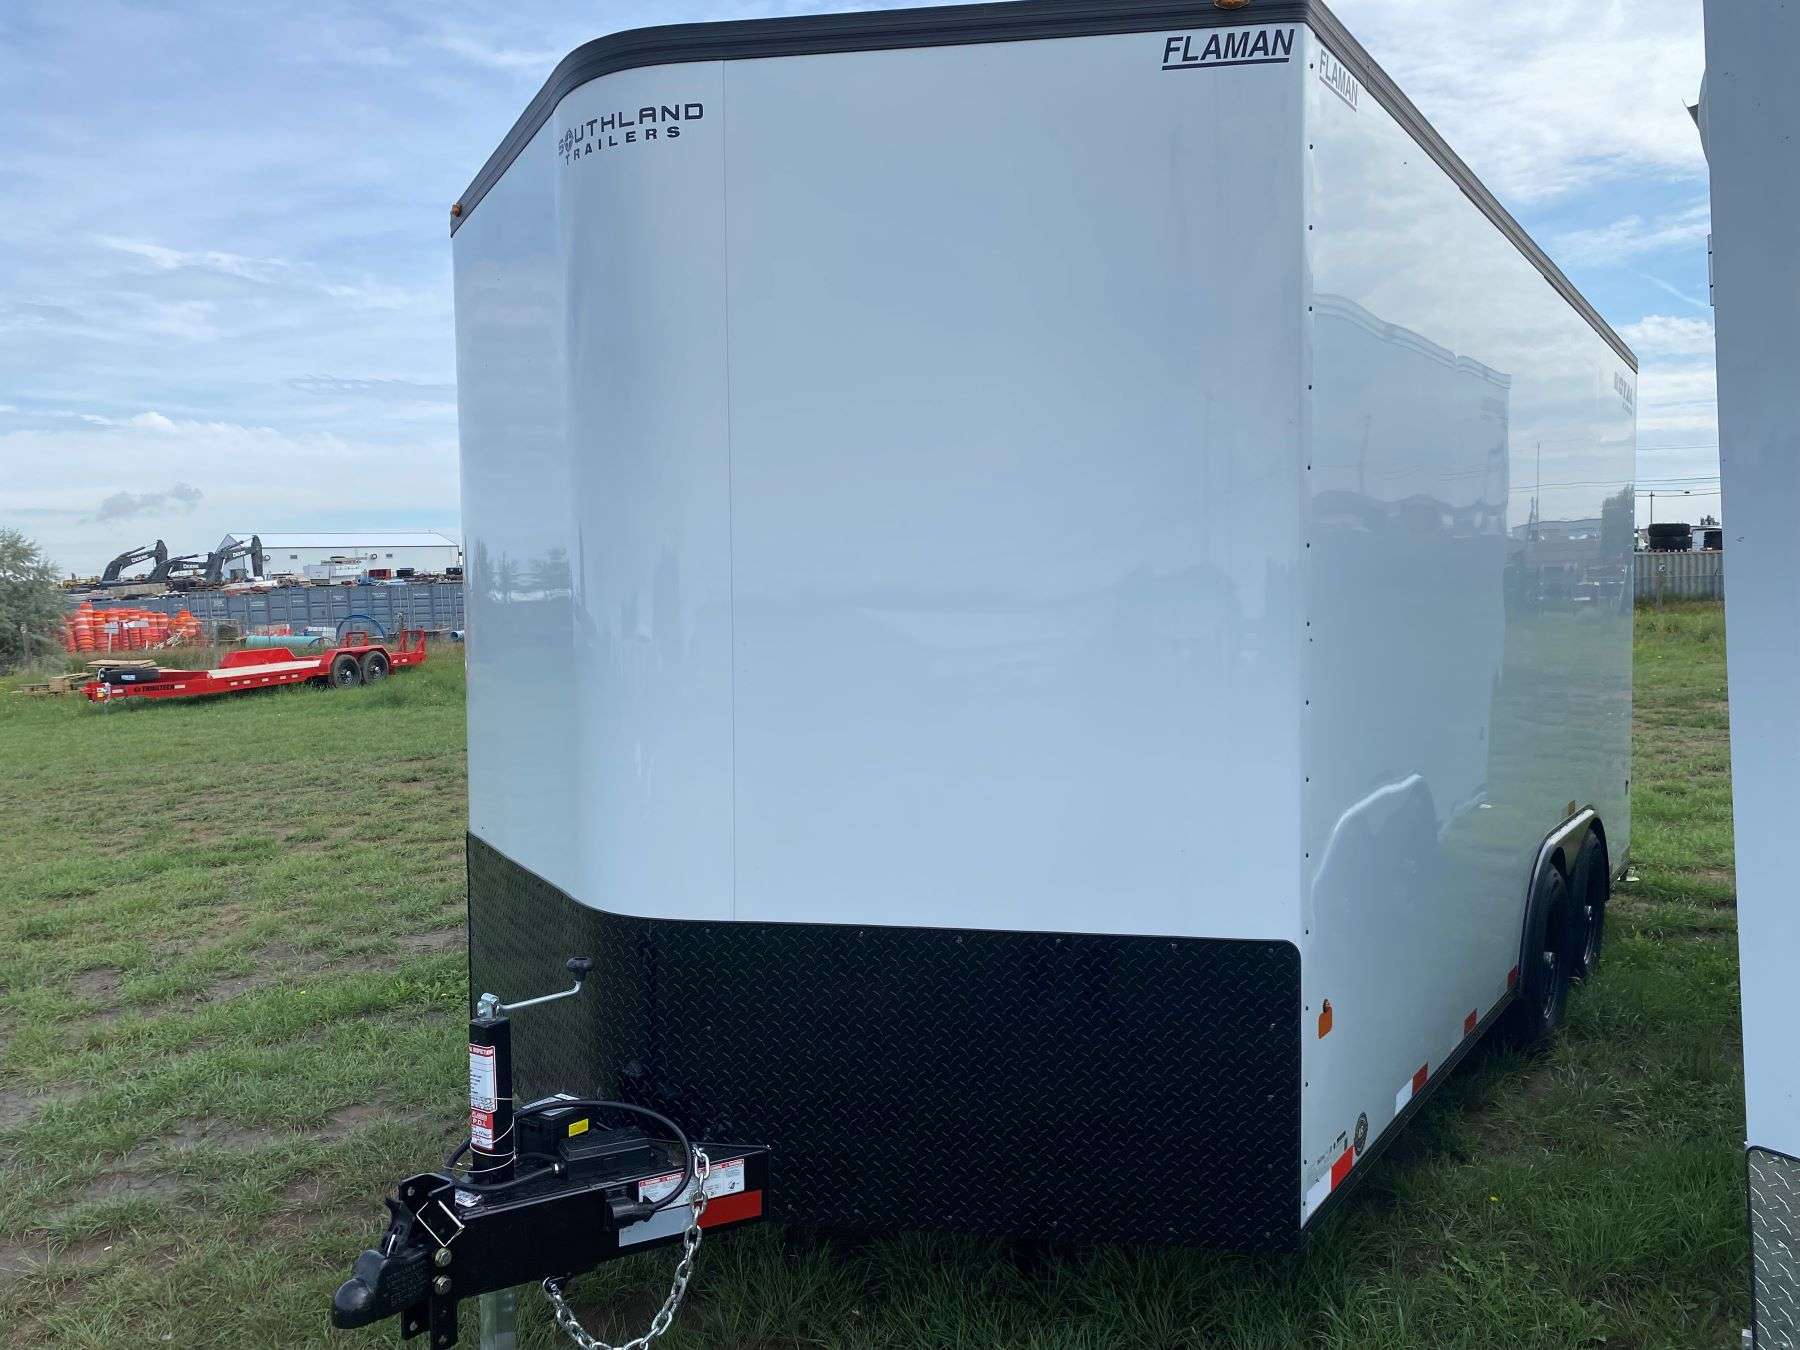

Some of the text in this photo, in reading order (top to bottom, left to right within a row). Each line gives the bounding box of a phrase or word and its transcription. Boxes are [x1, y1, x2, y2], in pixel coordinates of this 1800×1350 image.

[1162, 29, 1295, 64] FLAMAN
[1319, 48, 1359, 106] FLAMAN
[558, 102, 704, 155] SOUTHLAND
[565, 126, 681, 166] TRAILERS
